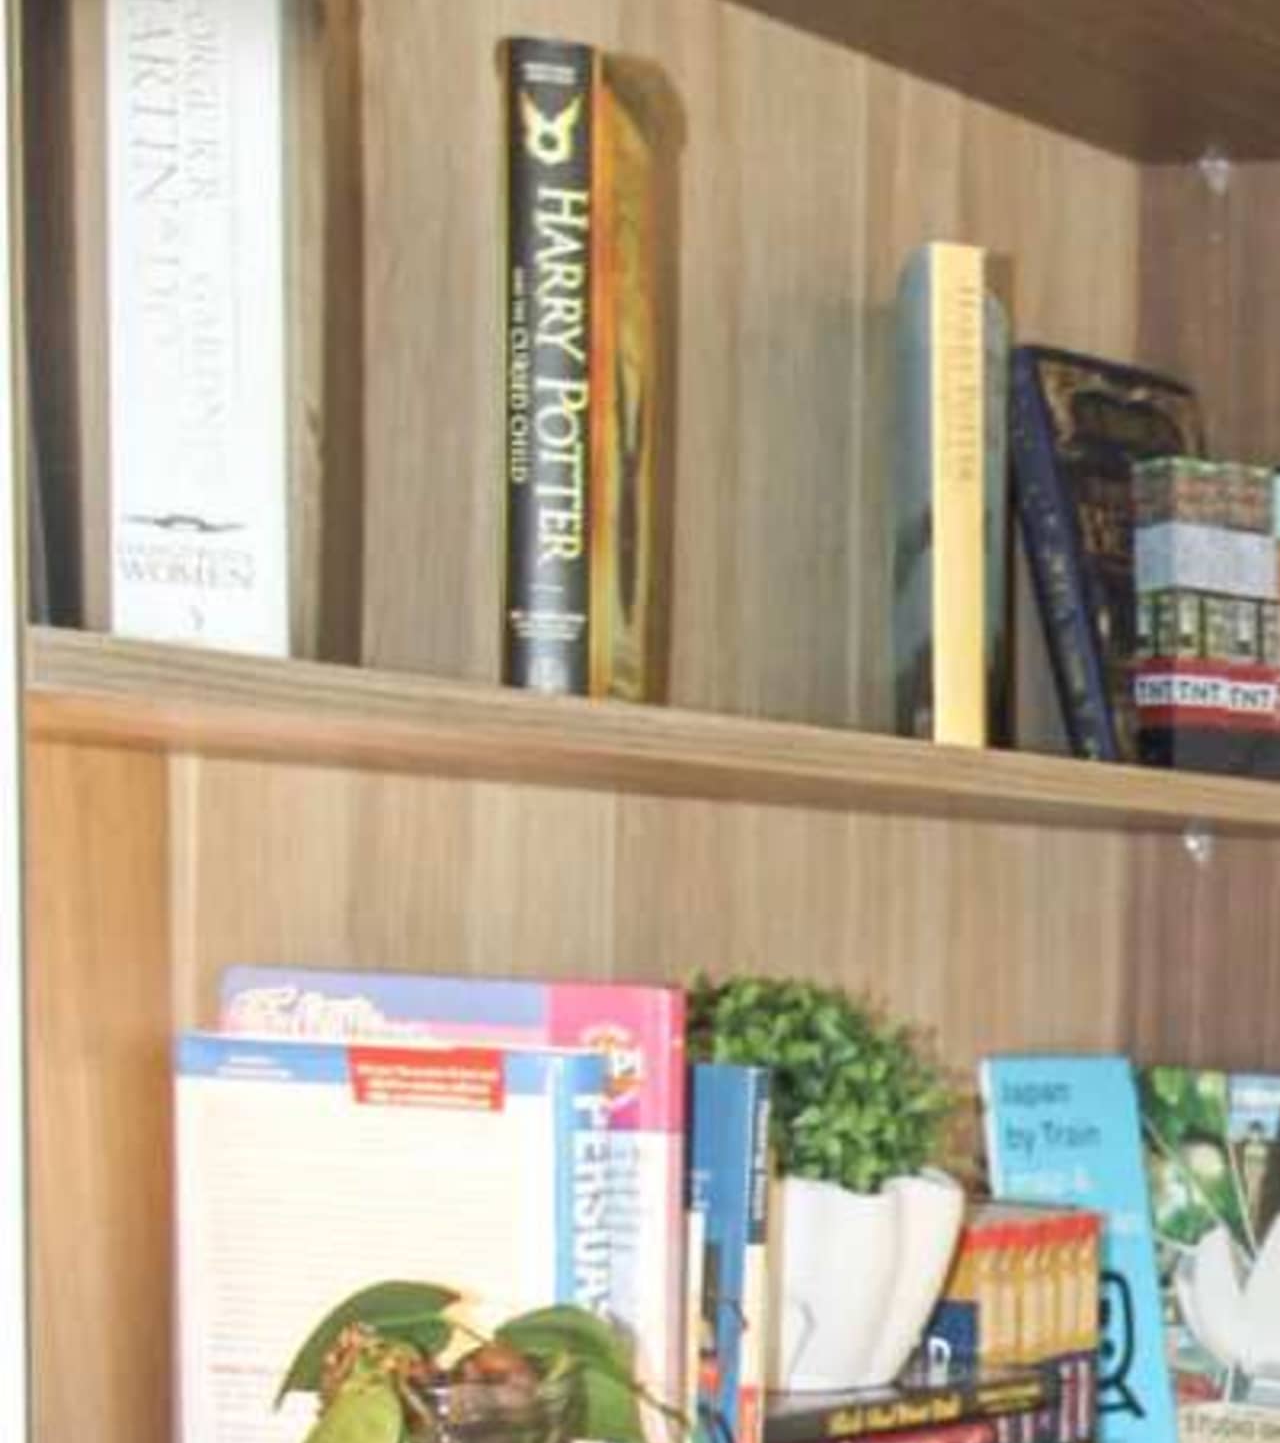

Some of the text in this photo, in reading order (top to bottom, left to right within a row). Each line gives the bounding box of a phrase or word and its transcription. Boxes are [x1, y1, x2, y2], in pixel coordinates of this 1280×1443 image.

[535, 187, 588, 369] HARRY
[535, 375, 590, 564] POTTER
[1178, 680, 1221, 700] TNT
[1230, 686, 1270, 707] TNT
[1002, 1081, 1070, 1109] Japan
[1005, 1117, 1100, 1159] by Train
